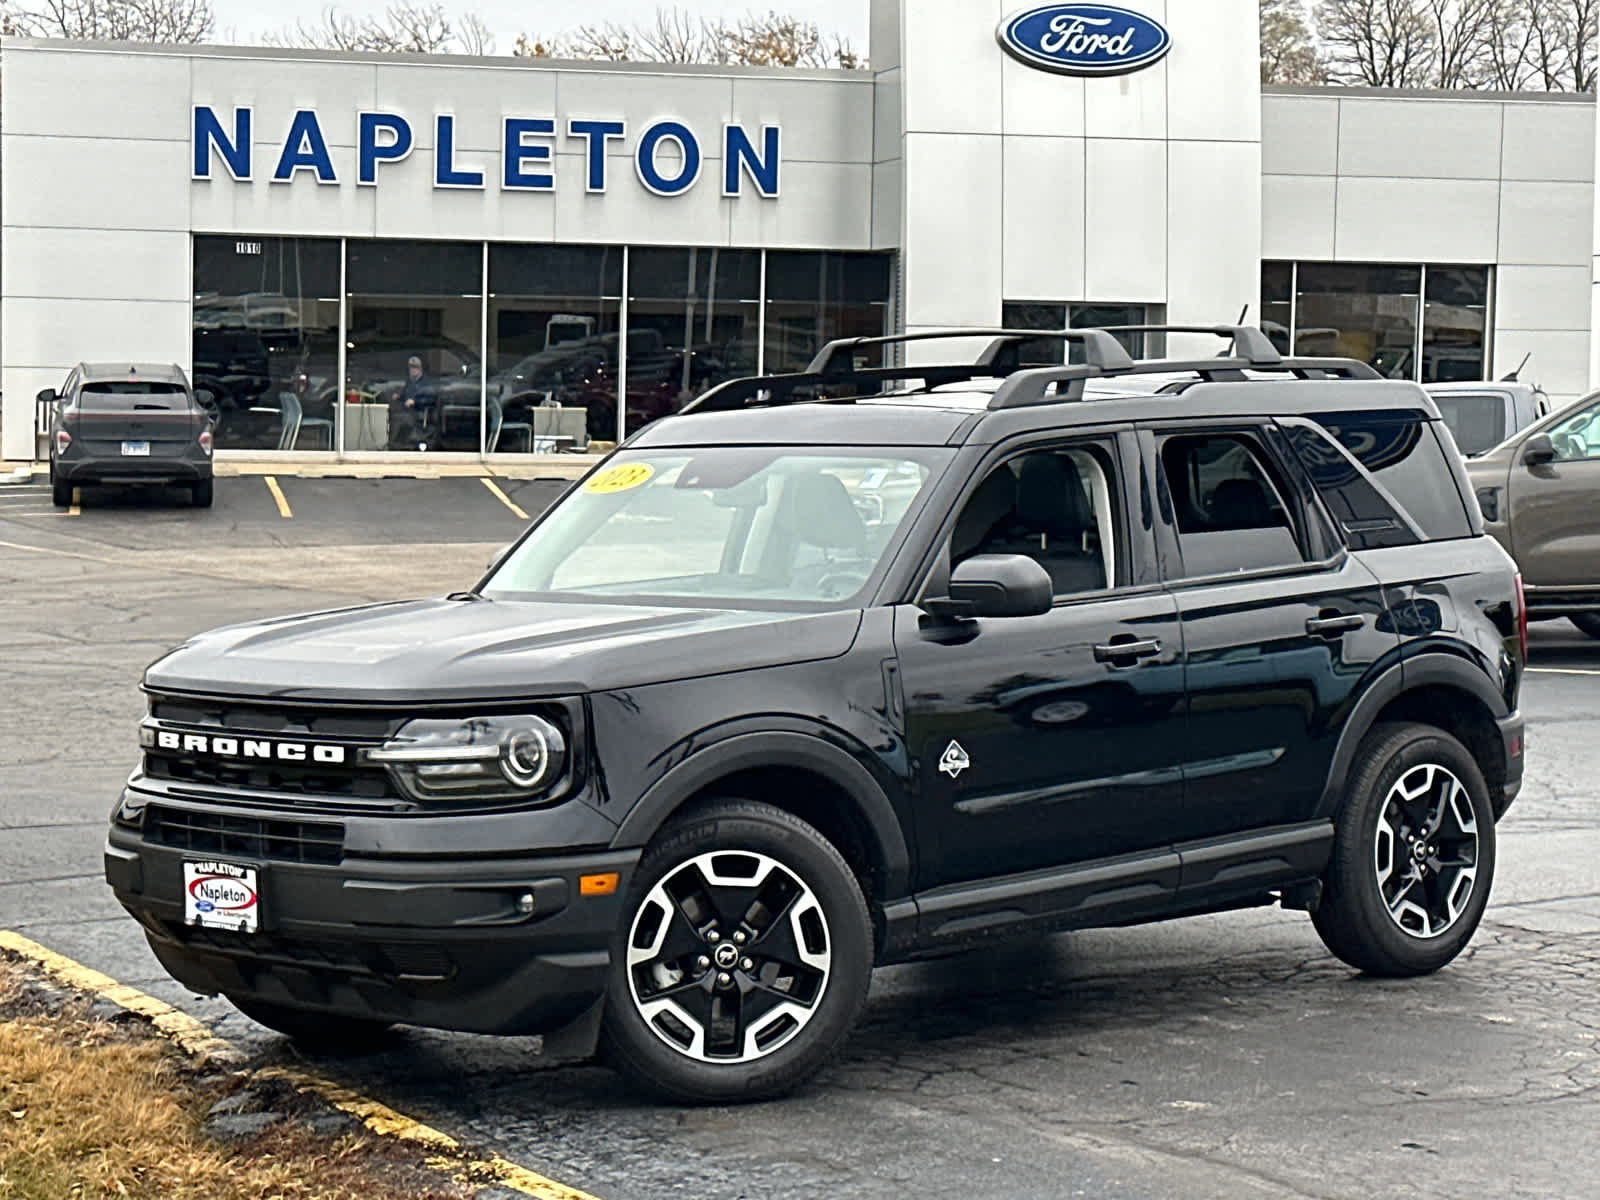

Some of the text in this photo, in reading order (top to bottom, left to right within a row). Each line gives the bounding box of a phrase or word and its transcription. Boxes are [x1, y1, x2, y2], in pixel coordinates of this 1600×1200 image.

[1040, 14, 1136, 56] Ford
[190, 104, 782, 198] NAPLETON
[157, 731, 345, 763] BRONCO
[199, 882, 246, 903] Napleton
